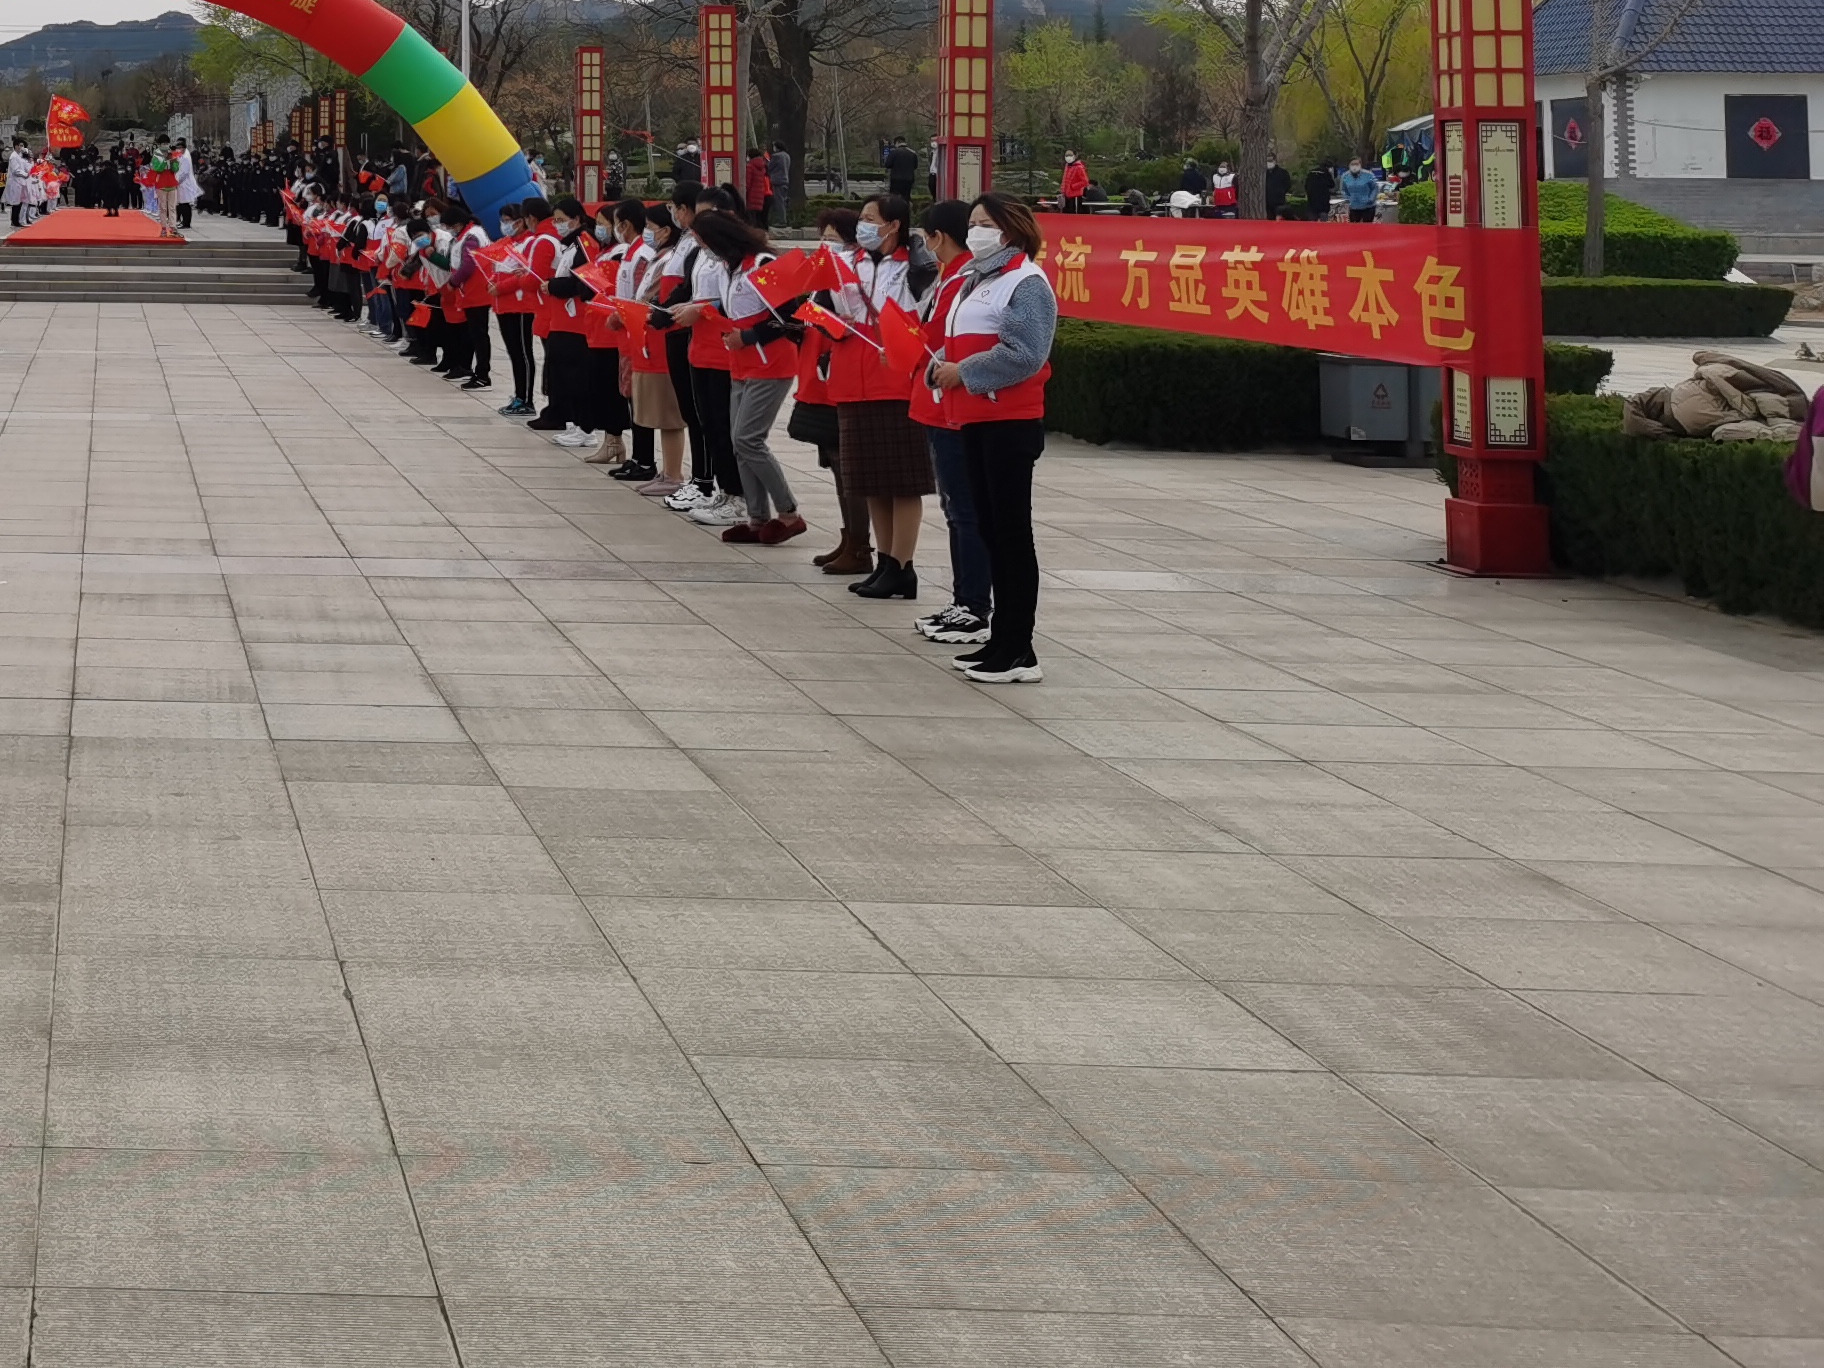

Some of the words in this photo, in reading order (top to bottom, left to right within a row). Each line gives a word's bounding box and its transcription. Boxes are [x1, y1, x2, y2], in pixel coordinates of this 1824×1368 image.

[1119, 238, 1475, 351] 方显英雄本色
